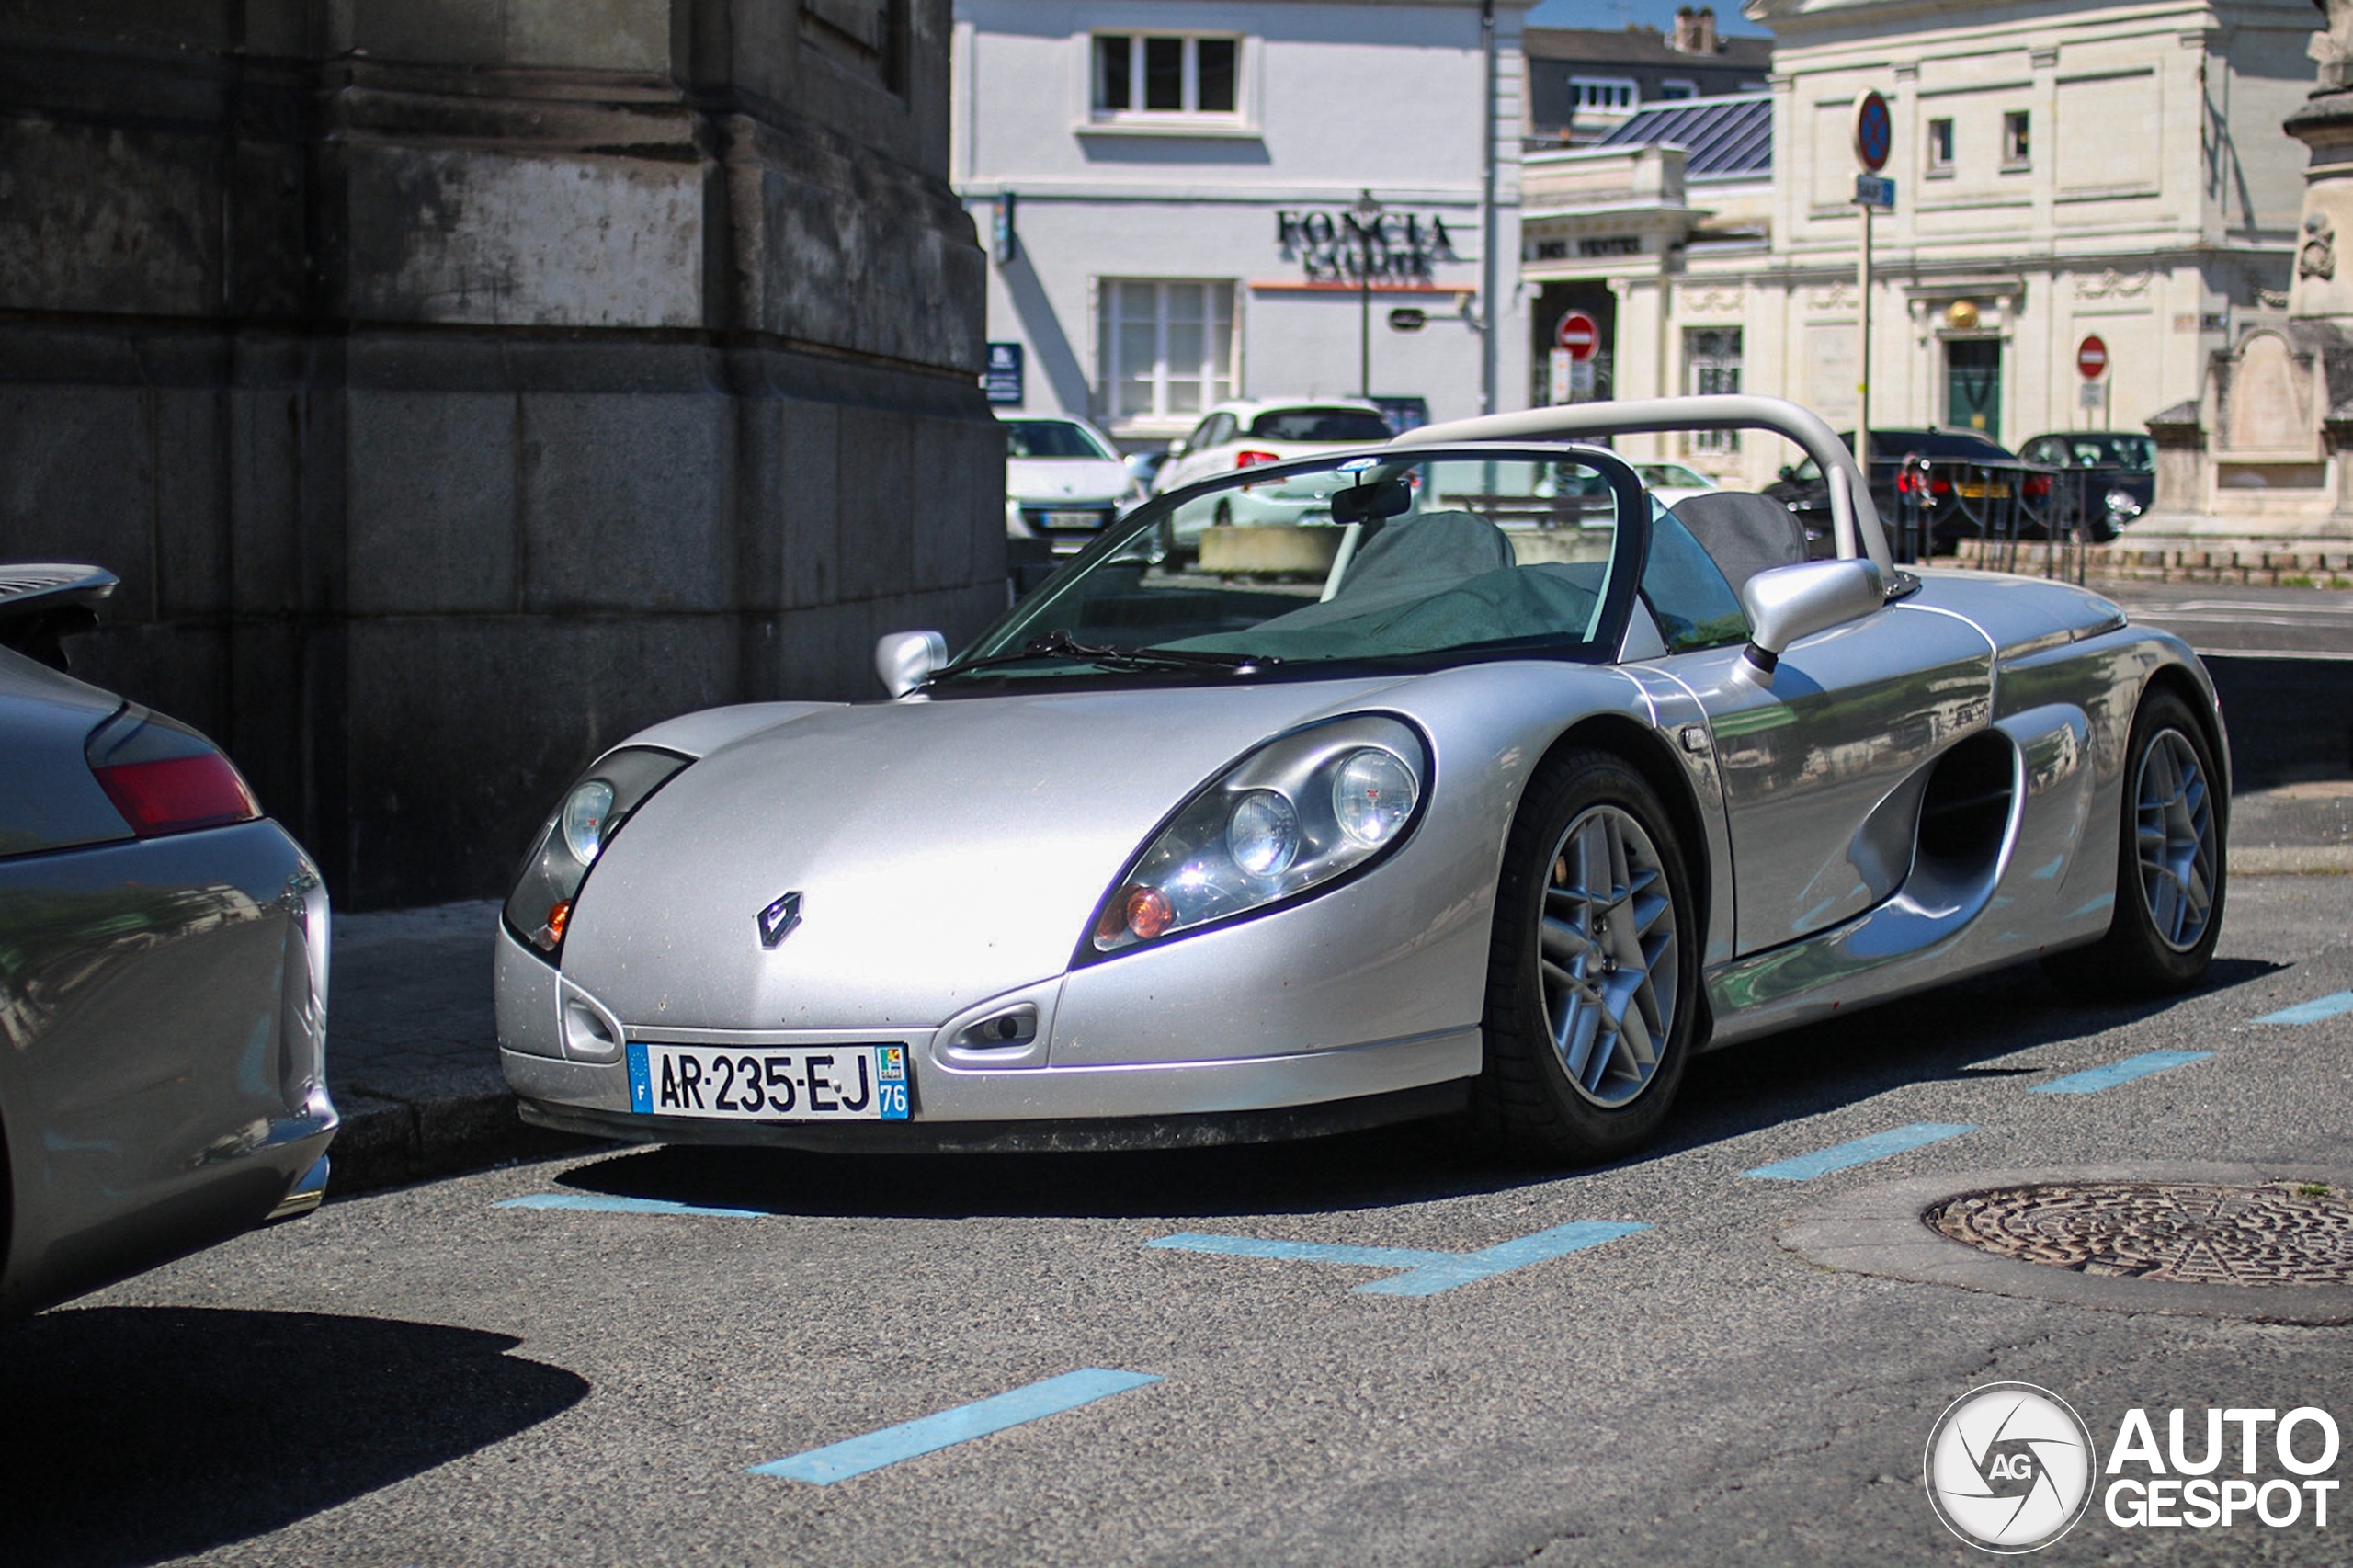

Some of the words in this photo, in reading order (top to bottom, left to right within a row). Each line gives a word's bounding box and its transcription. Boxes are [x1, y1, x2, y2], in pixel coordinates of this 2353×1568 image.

[1275, 210, 1451, 246] FONCIA
[637, 1085, 645, 1101] F
[660, 1053, 870, 1113] AR-235-EJ
[880, 1085, 907, 1112] 76
